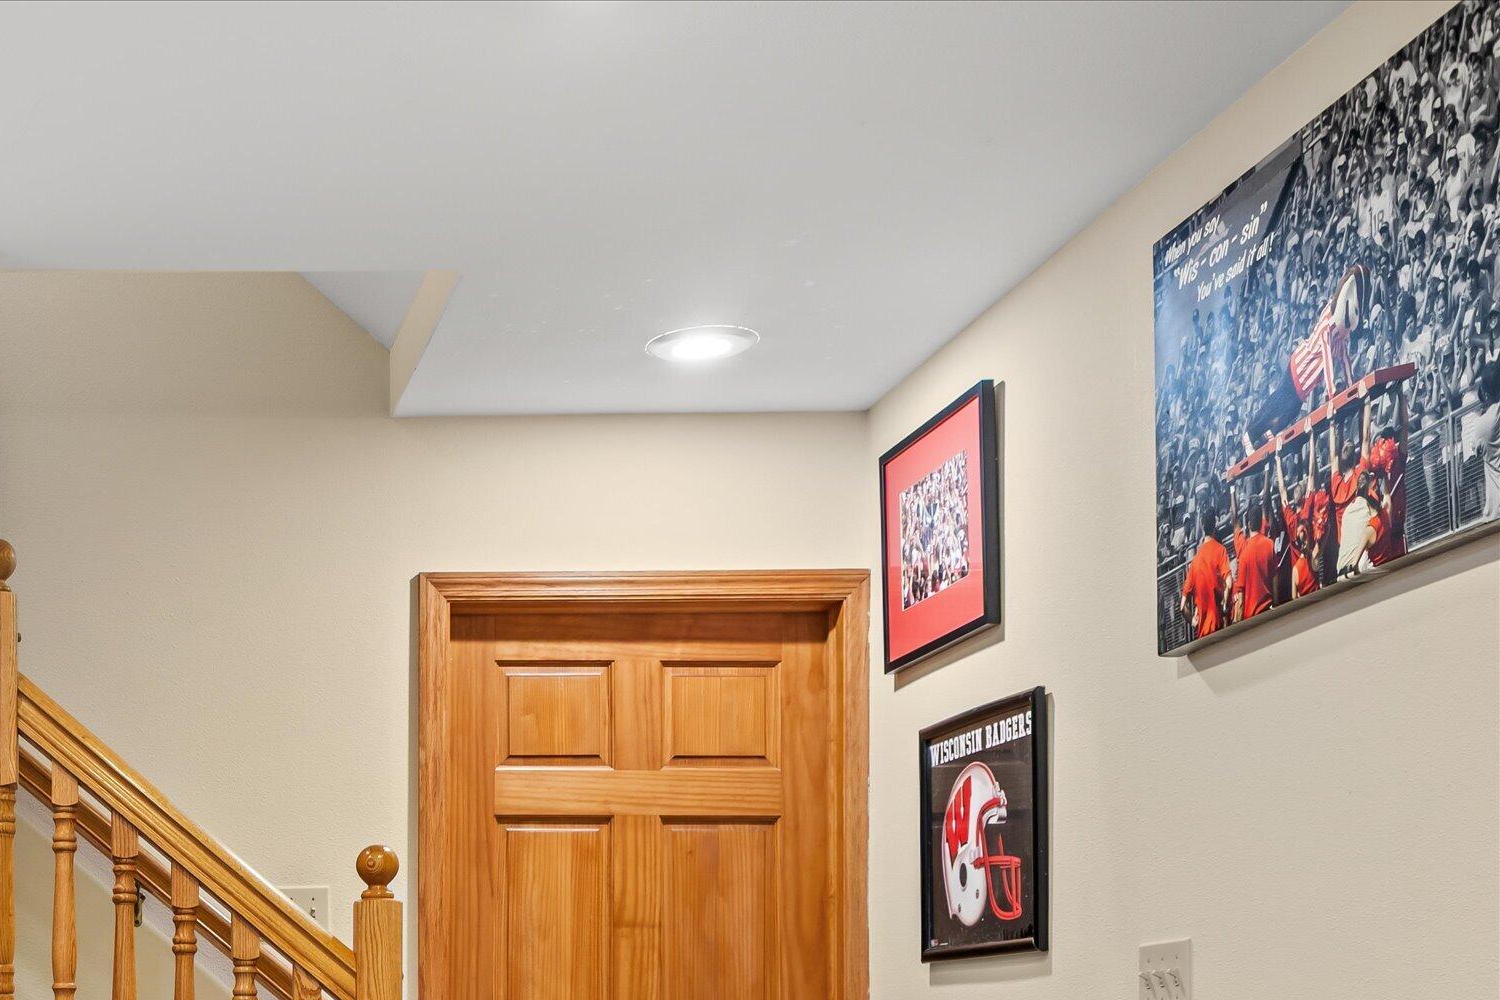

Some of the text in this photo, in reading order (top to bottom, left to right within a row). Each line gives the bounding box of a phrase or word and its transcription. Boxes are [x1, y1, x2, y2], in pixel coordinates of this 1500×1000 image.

[1164, 214, 1221, 267] When you say
[1197, 231, 1275, 303] You've said it all!
[1209, 239, 1230, 267] con
[929, 710, 1032, 768] WISCONSIN BADGERS
[945, 775, 972, 870] W
